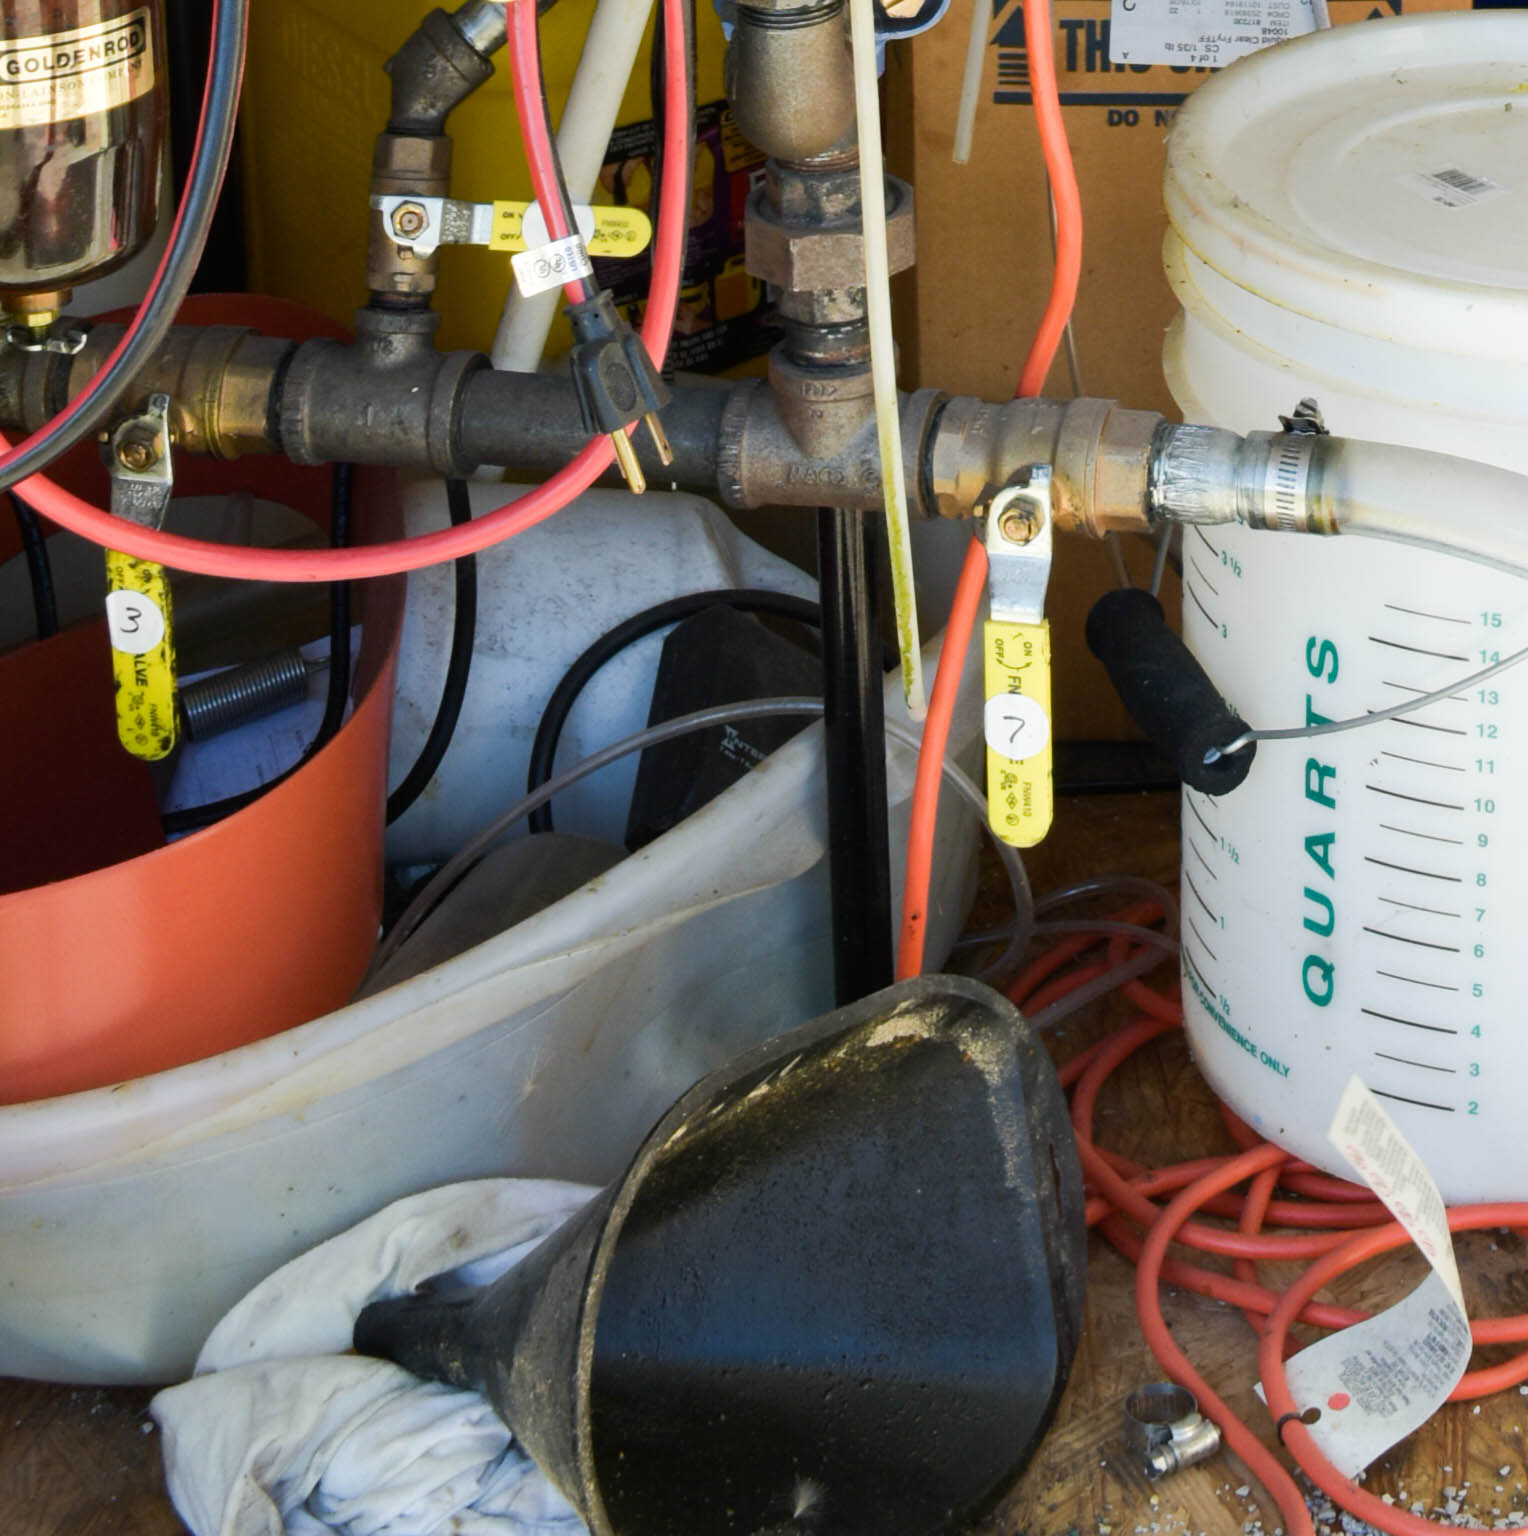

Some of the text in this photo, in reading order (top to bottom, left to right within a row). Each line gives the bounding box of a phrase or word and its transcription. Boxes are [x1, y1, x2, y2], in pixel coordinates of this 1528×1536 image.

[1233, 34, 1258, 44] Clear
[5, 27, 142, 77] GOLDENROD
[1120, 51, 1128, 59] A
[1204, 43, 1219, 52] CS
[1198, 54, 1208, 62] of
[1108, 110, 1138, 126] DO
[119, 606, 144, 635] 3
[1480, 612, 1502, 628] 15
[1221, 623, 1229, 639] 3
[994, 638, 1005, 661] OFF
[1022, 640, 1033, 658] ON
[1479, 650, 1501, 665] 14
[1007, 675, 1022, 696] FN
[1477, 690, 1499, 705] 13
[1001, 714, 1026, 745] 7
[1476, 724, 1498, 739] 12
[1475, 759, 1495, 774] 11
[1022, 780, 1033, 818] FNW410
[1473, 798, 1496, 814] 10
[1302, 635, 1339, 1008] QUARTS
[1477, 833, 1489, 848] 9
[1475, 872, 1487, 887] 8
[1474, 908, 1486, 922] 7
[1473, 943, 1485, 958] 6
[1471, 983, 1483, 998] 5
[1470, 1024, 1482, 1039] 4
[1259, 1050, 1291, 1079] ONLY
[1469, 1062, 1481, 1077] 3
[1467, 1100, 1480, 1115] 2
